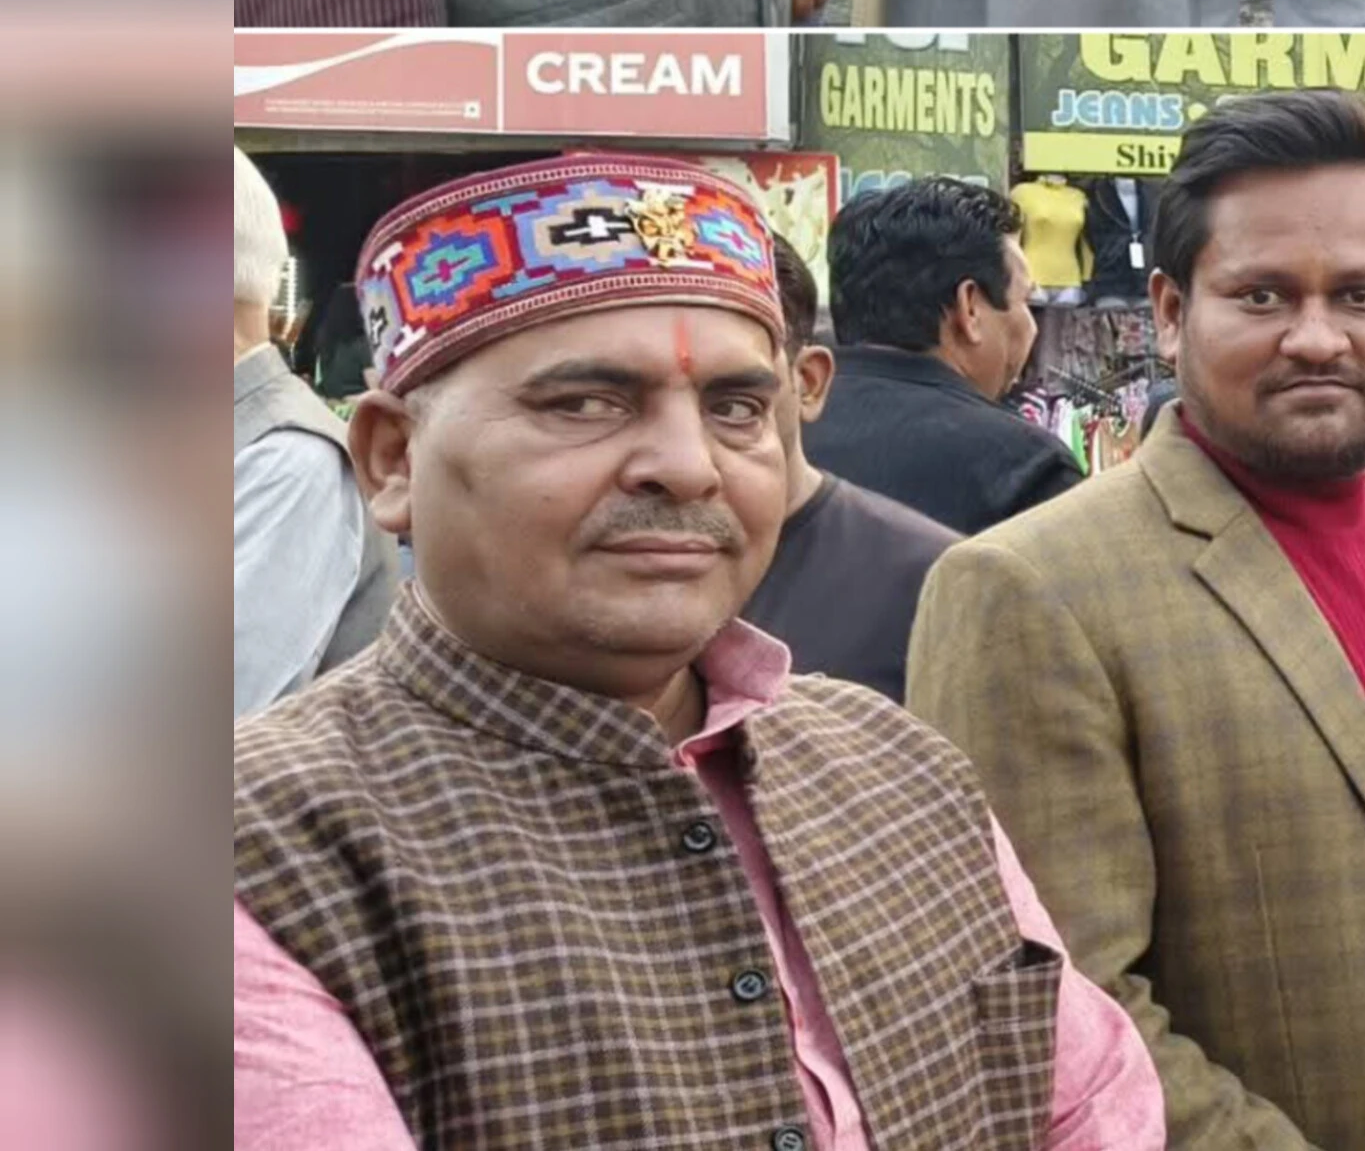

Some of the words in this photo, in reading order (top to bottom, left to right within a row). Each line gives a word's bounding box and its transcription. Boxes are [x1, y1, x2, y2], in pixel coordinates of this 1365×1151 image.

[526, 52, 742, 96] CREAM
[820, 62, 996, 137] GARMENTS
[1052, 89, 1184, 130] JEANS
